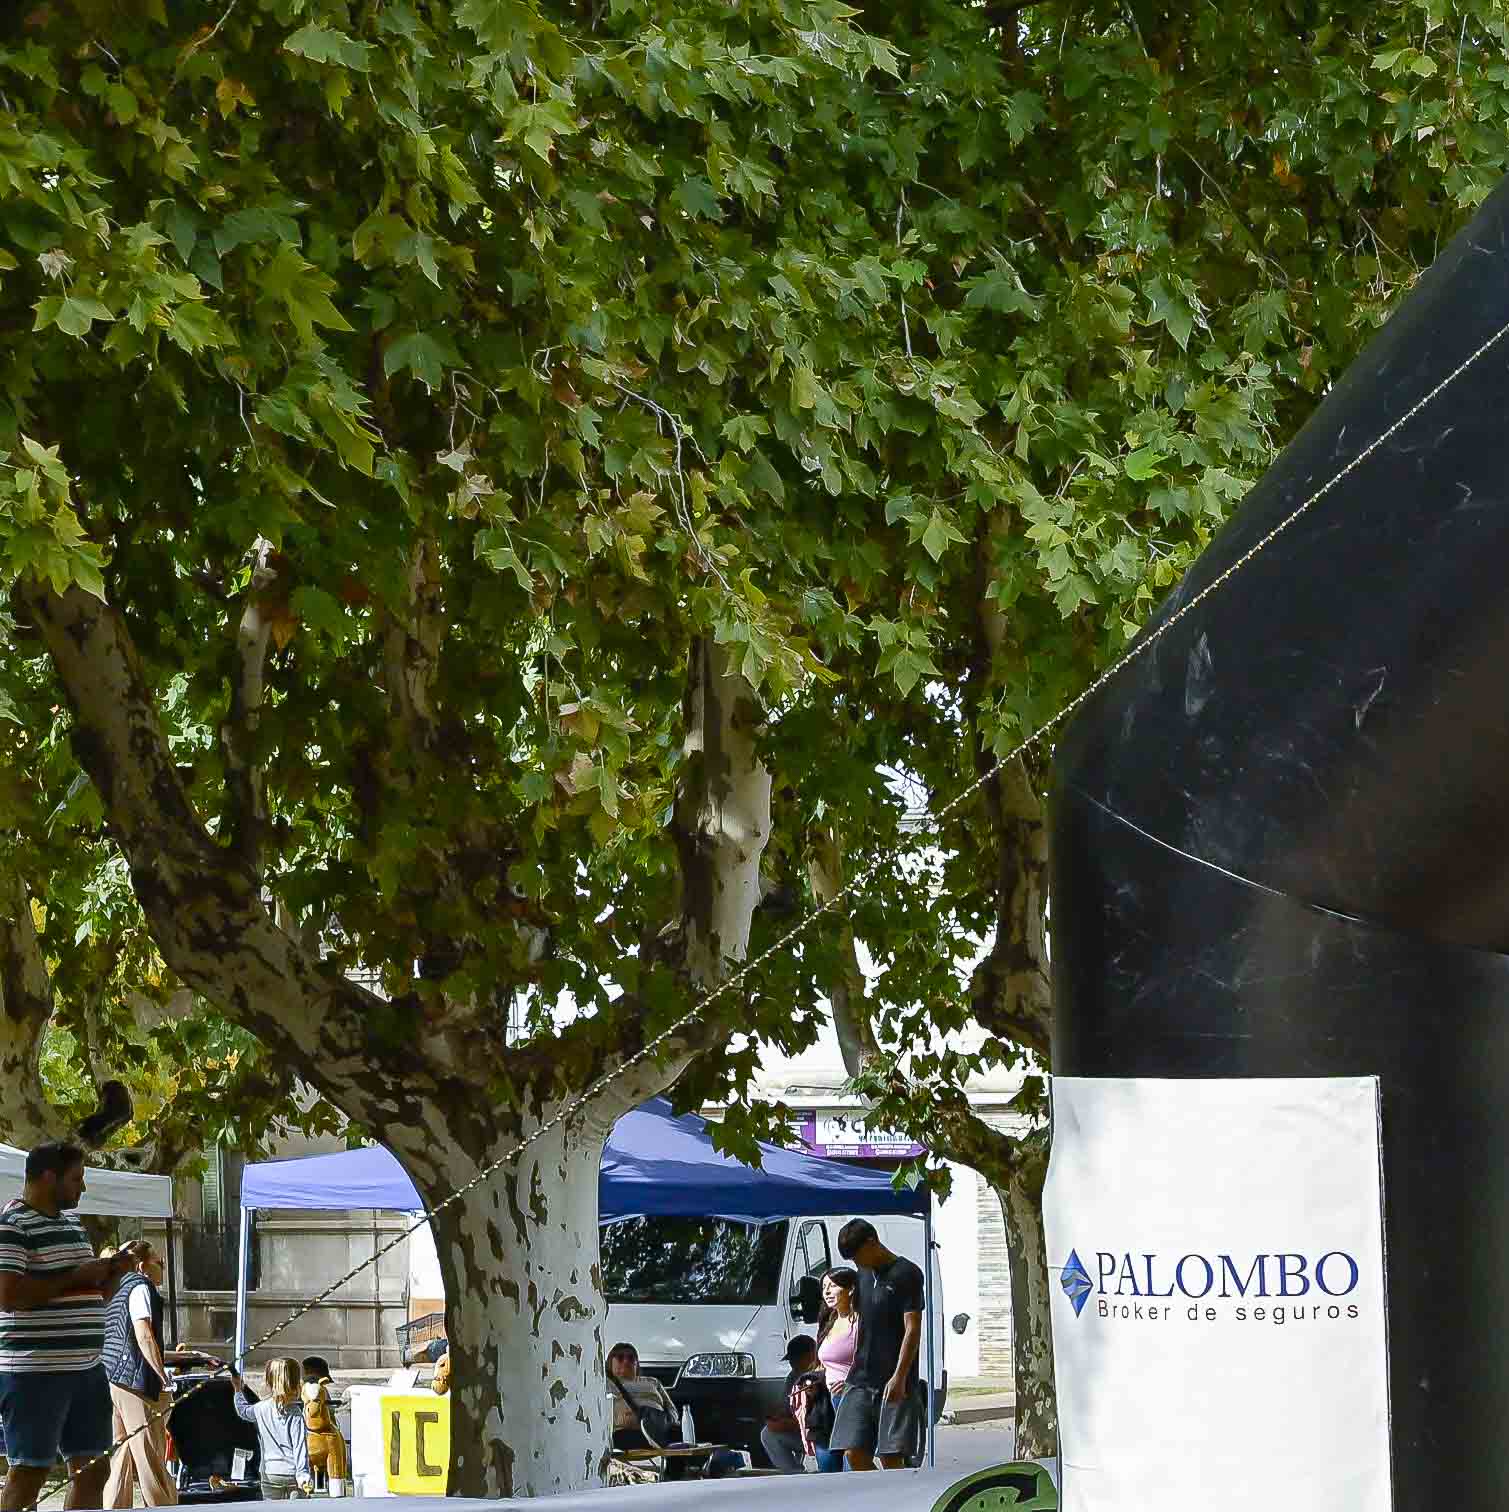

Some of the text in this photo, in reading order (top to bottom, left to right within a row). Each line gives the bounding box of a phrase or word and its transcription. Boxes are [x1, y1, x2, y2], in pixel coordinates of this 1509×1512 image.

[1095, 1251, 1360, 1298] PALOMBO
[1098, 1299, 1359, 1325] Broker de seguros
